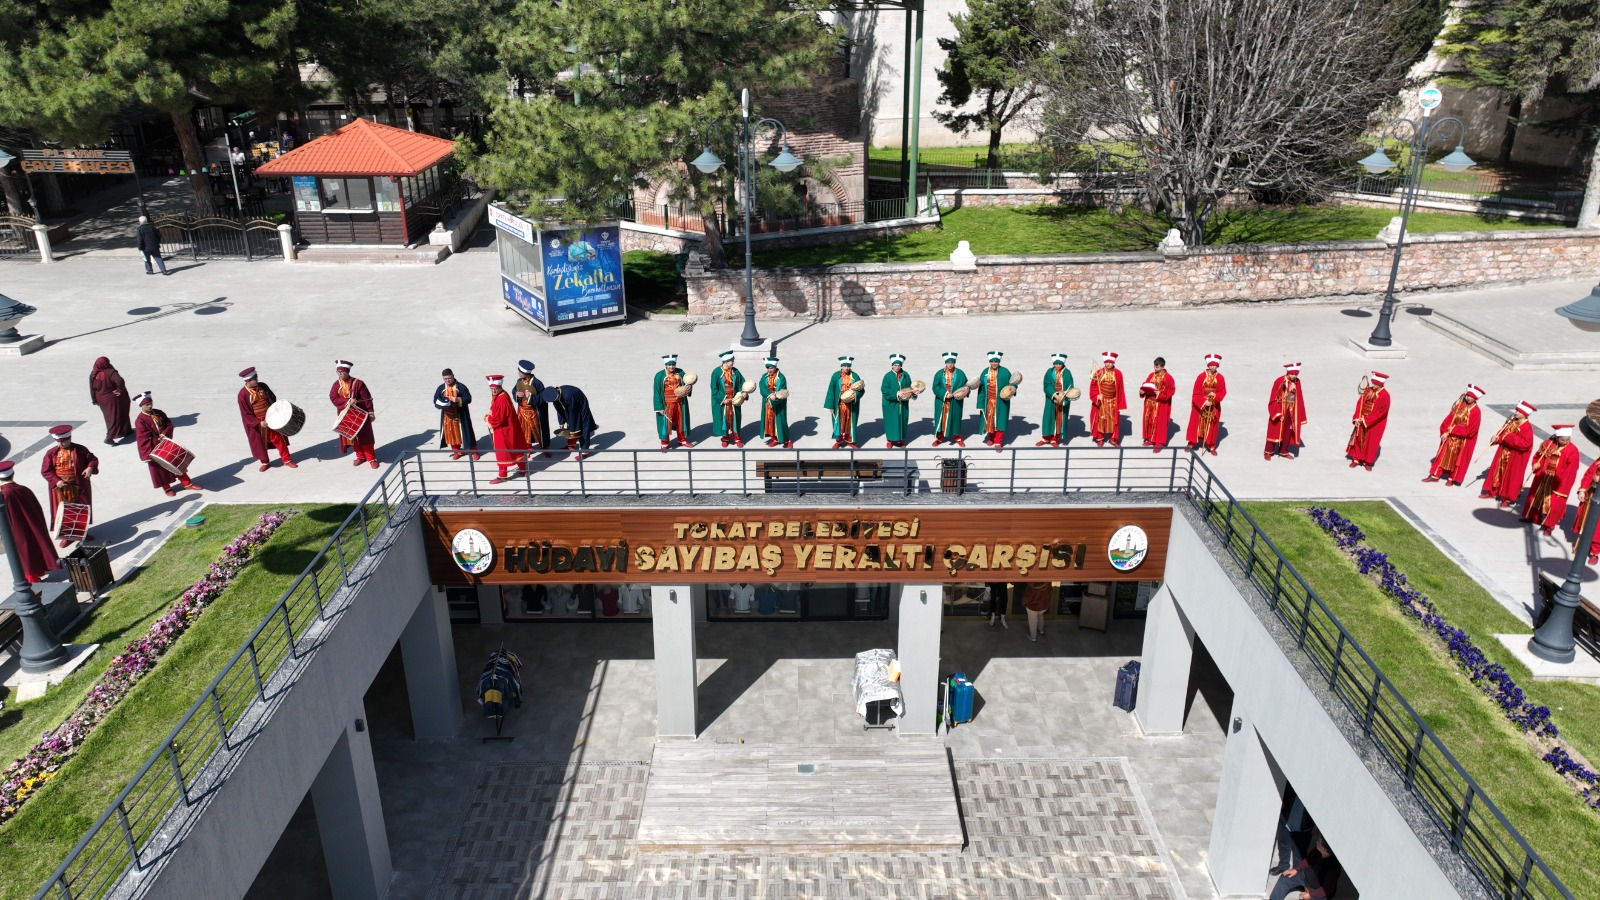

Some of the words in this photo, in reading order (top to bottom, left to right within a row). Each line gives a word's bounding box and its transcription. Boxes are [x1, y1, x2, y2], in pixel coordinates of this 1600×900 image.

[43, 149, 104, 158] PLEVNE
[20, 160, 55, 174] ÇAY
[673, 521, 762, 539] TOKAT
[768, 516, 919, 538] BELEDİYESİ
[504, 540, 628, 571] HÜDAYİ
[635, 544, 782, 575] SAYIBAŞ
[792, 543, 935, 569] YERALTI
[943, 543, 1086, 574] ÇARŞISI
